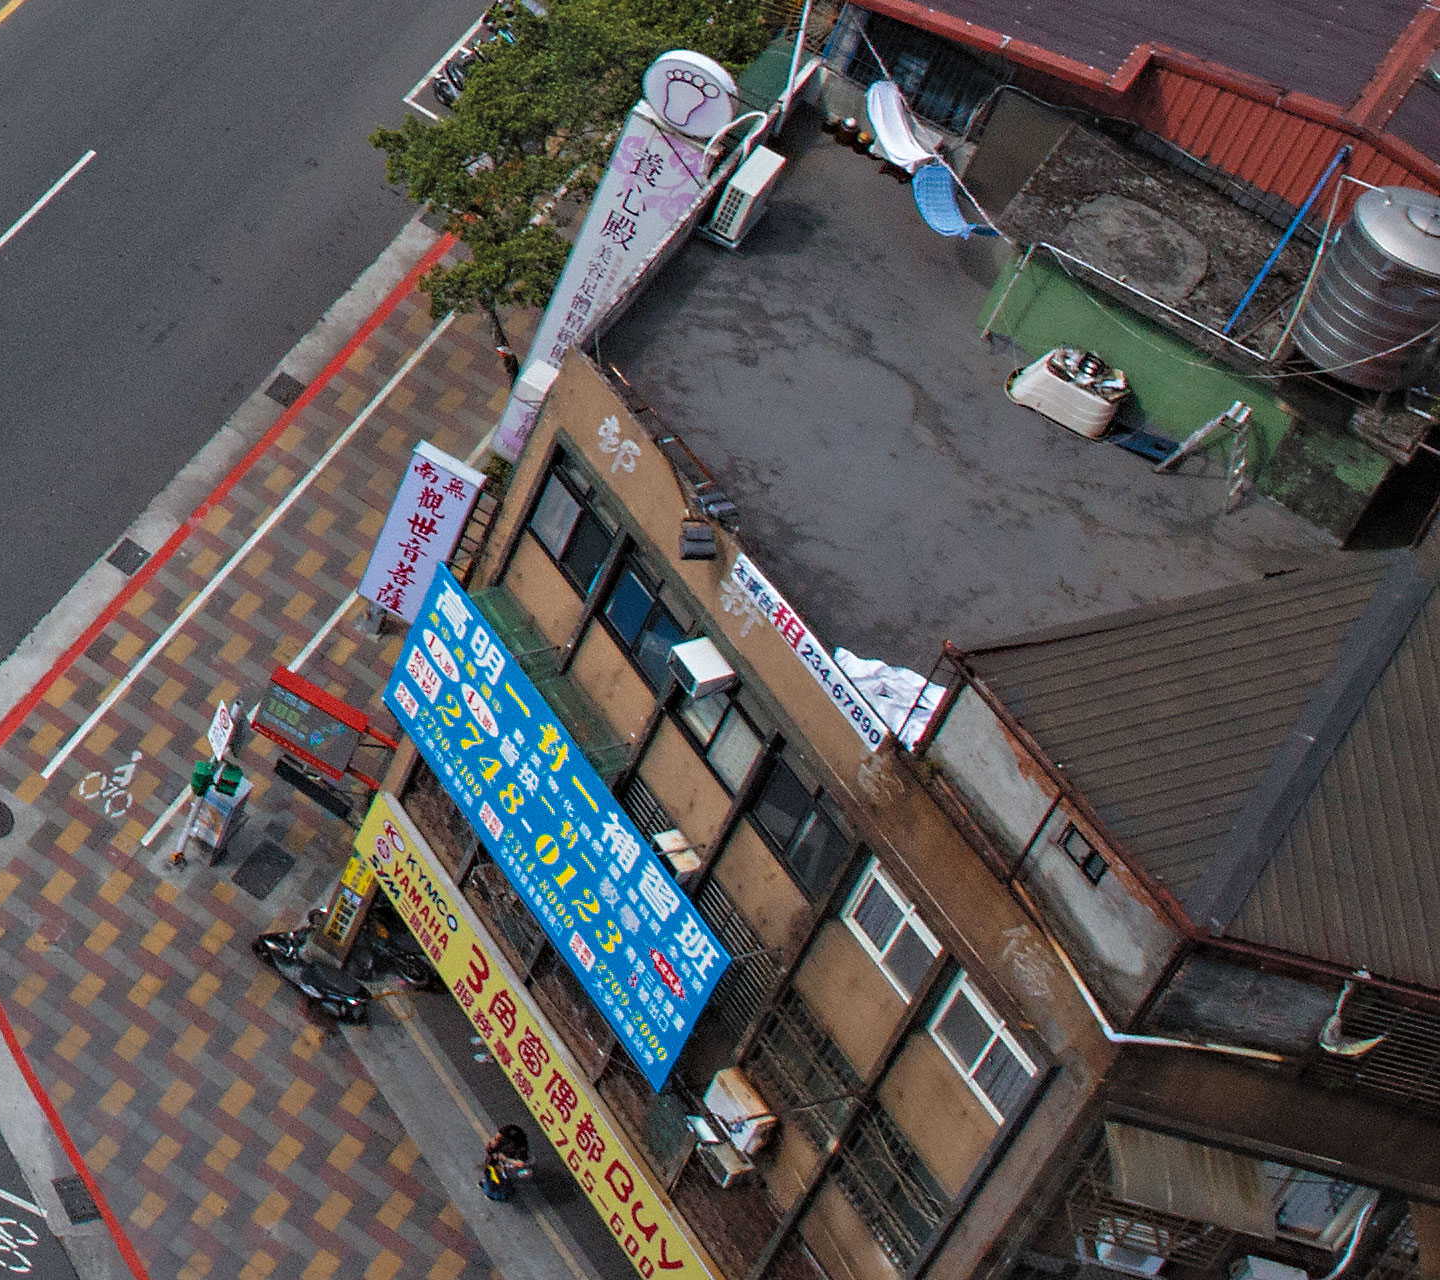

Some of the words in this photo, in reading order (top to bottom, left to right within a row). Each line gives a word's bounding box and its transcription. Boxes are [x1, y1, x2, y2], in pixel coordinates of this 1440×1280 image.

[436, 580, 720, 981] 高明一對一補習班
[436, 693, 623, 954] 2748-0123
[369, 855, 400, 900] SYM
[393, 860, 449, 951] YAMAHA
[405, 853, 459, 932] KYMCO
[594, 959, 669, 1061] 2709-2000
